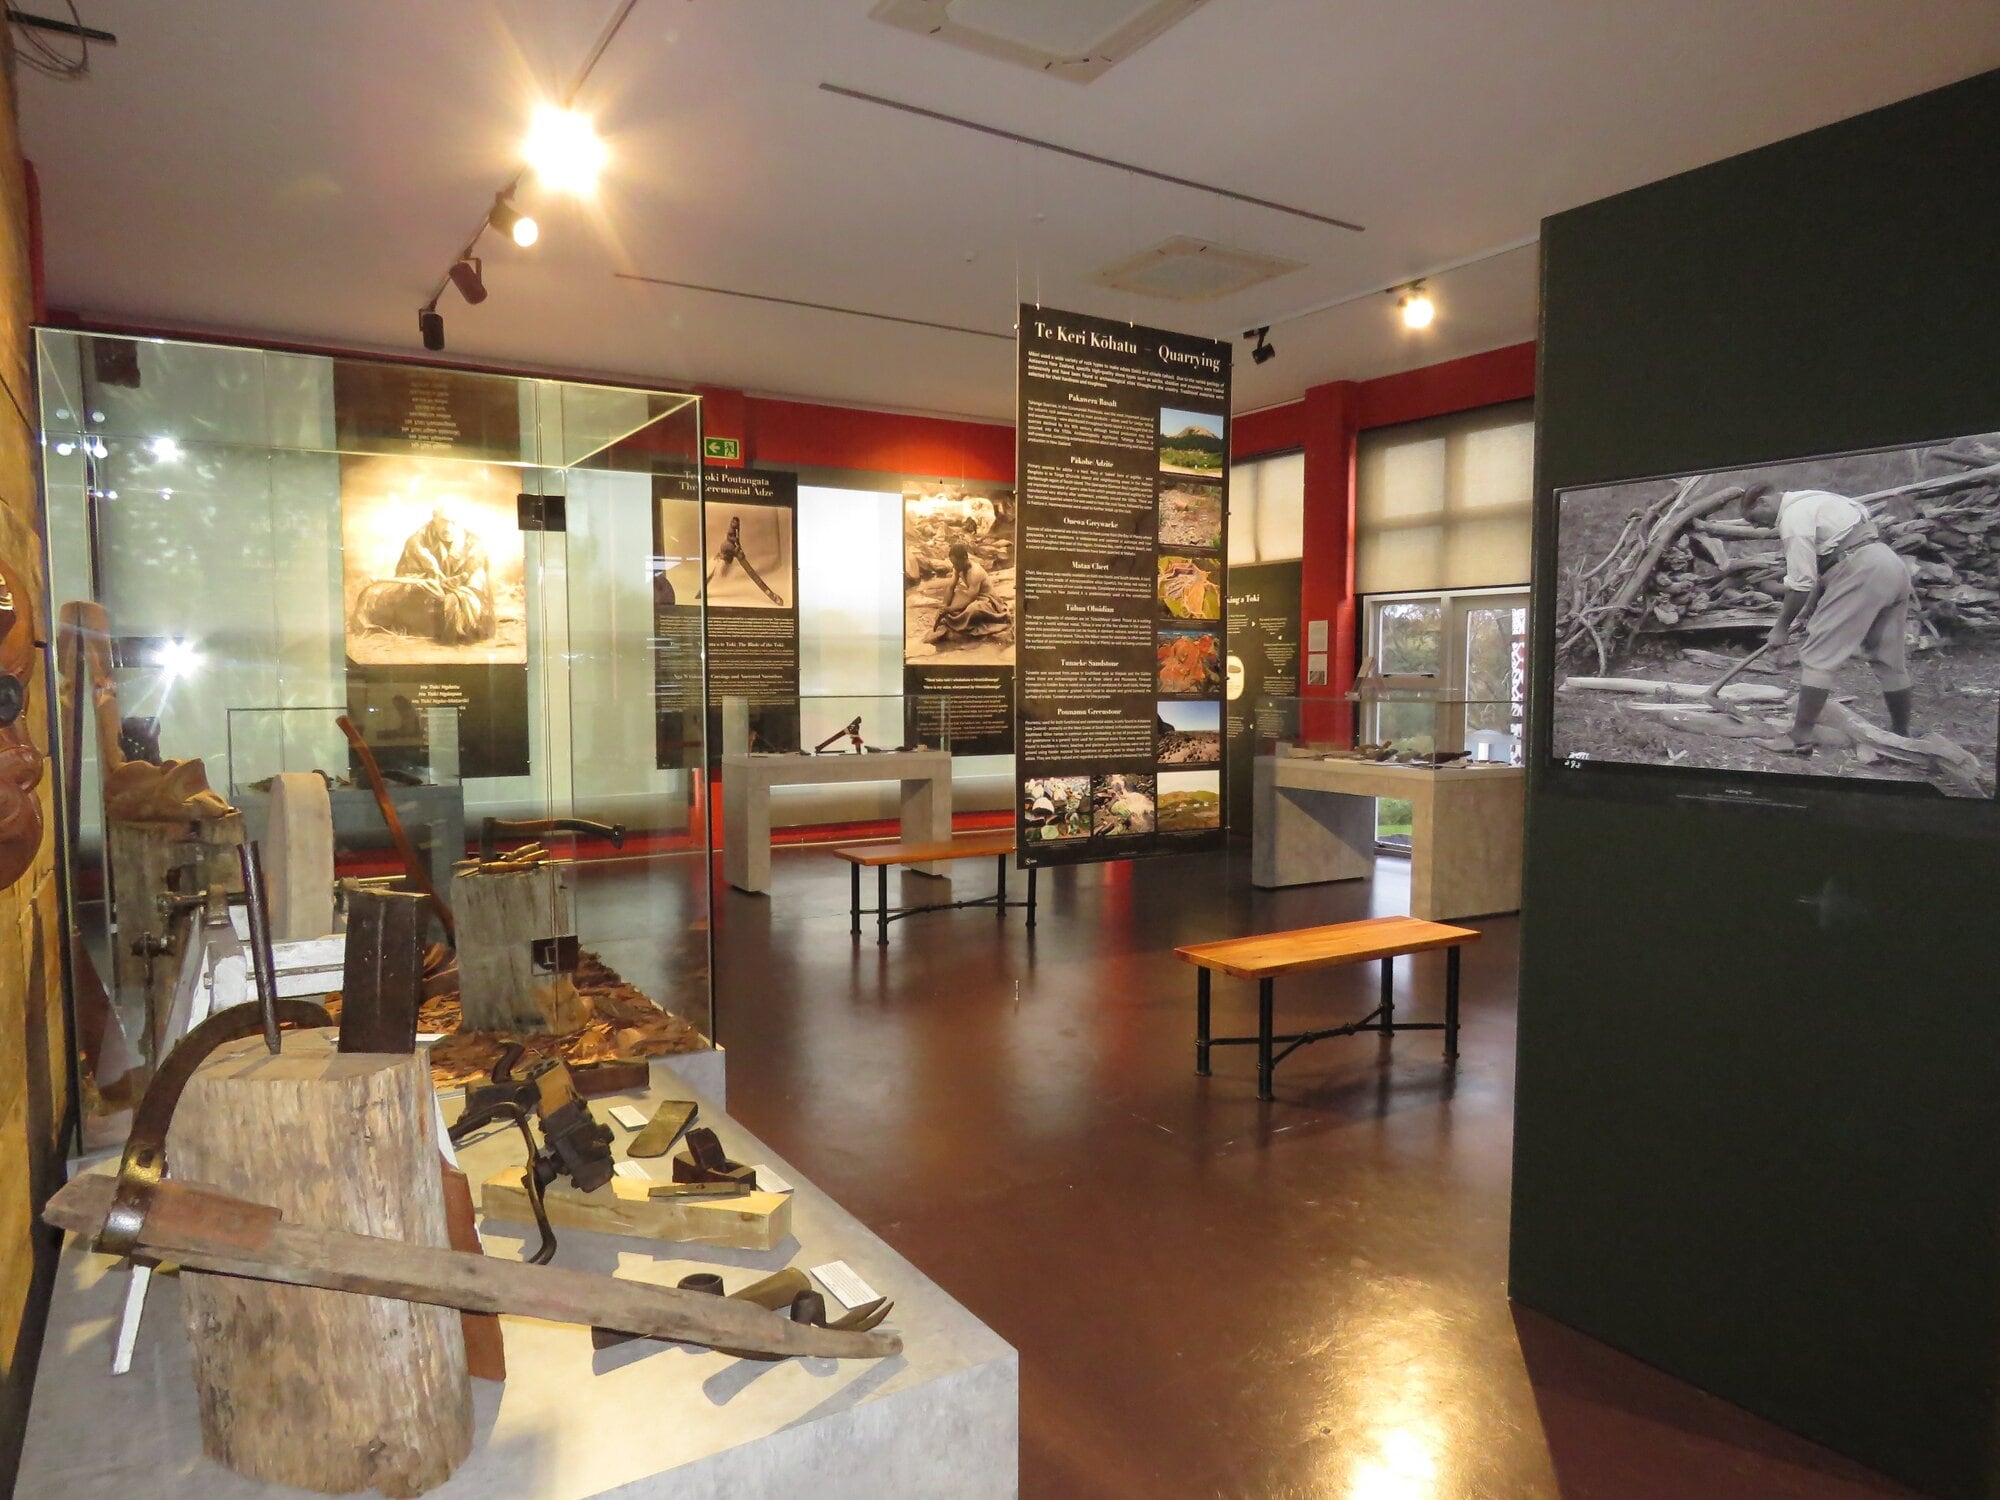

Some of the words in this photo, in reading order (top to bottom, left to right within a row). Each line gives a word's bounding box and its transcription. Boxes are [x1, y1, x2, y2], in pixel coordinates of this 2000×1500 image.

[1035, 322, 1053, 339] Te
[1057, 326, 1086, 345] Keri
[1091, 332, 1137, 354] Kōhatu
[1159, 345, 1221, 372] Quarrying
[704, 472, 719, 481] oki
[721, 473, 769, 487] Poutangata
[753, 487, 773, 496] Adze
[1244, 593, 1259, 602] Toki
[1087, 605, 1114, 613] Obsidian
